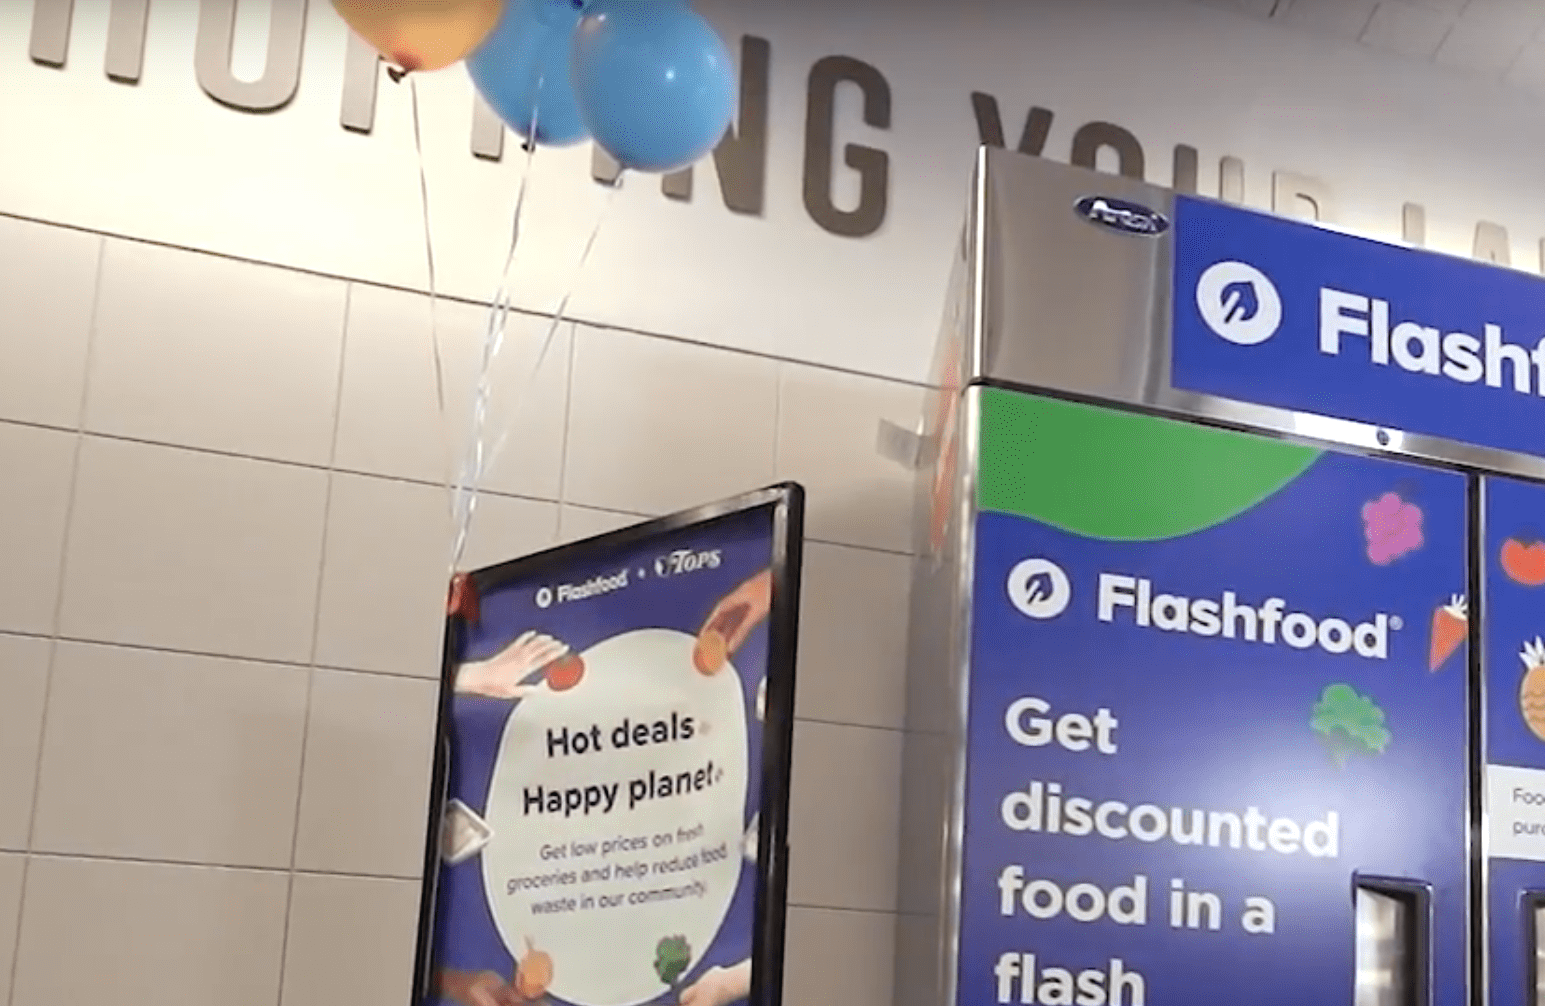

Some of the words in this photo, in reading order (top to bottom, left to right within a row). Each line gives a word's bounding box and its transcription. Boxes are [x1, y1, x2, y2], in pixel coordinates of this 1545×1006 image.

[547, 724, 602, 758] Hot
[1005, 697, 1118, 754] Get
[523, 783, 619, 818] Happy
[1001, 781, 1339, 858] discounted
[539, 844, 567, 861] Get
[571, 841, 598, 858] low
[601, 835, 647, 858] prices
[652, 833, 673, 848] on
[507, 869, 577, 896] groceries
[581, 865, 611, 884] and
[614, 860, 648, 881] help
[652, 854, 698, 875] reduce
[531, 897, 577, 915] waste
[580, 893, 595, 910] in
[599, 892, 624, 908] our
[998, 865, 1148, 925] food
[1170, 878, 1222, 931] in
[1241, 894, 1275, 934] a
